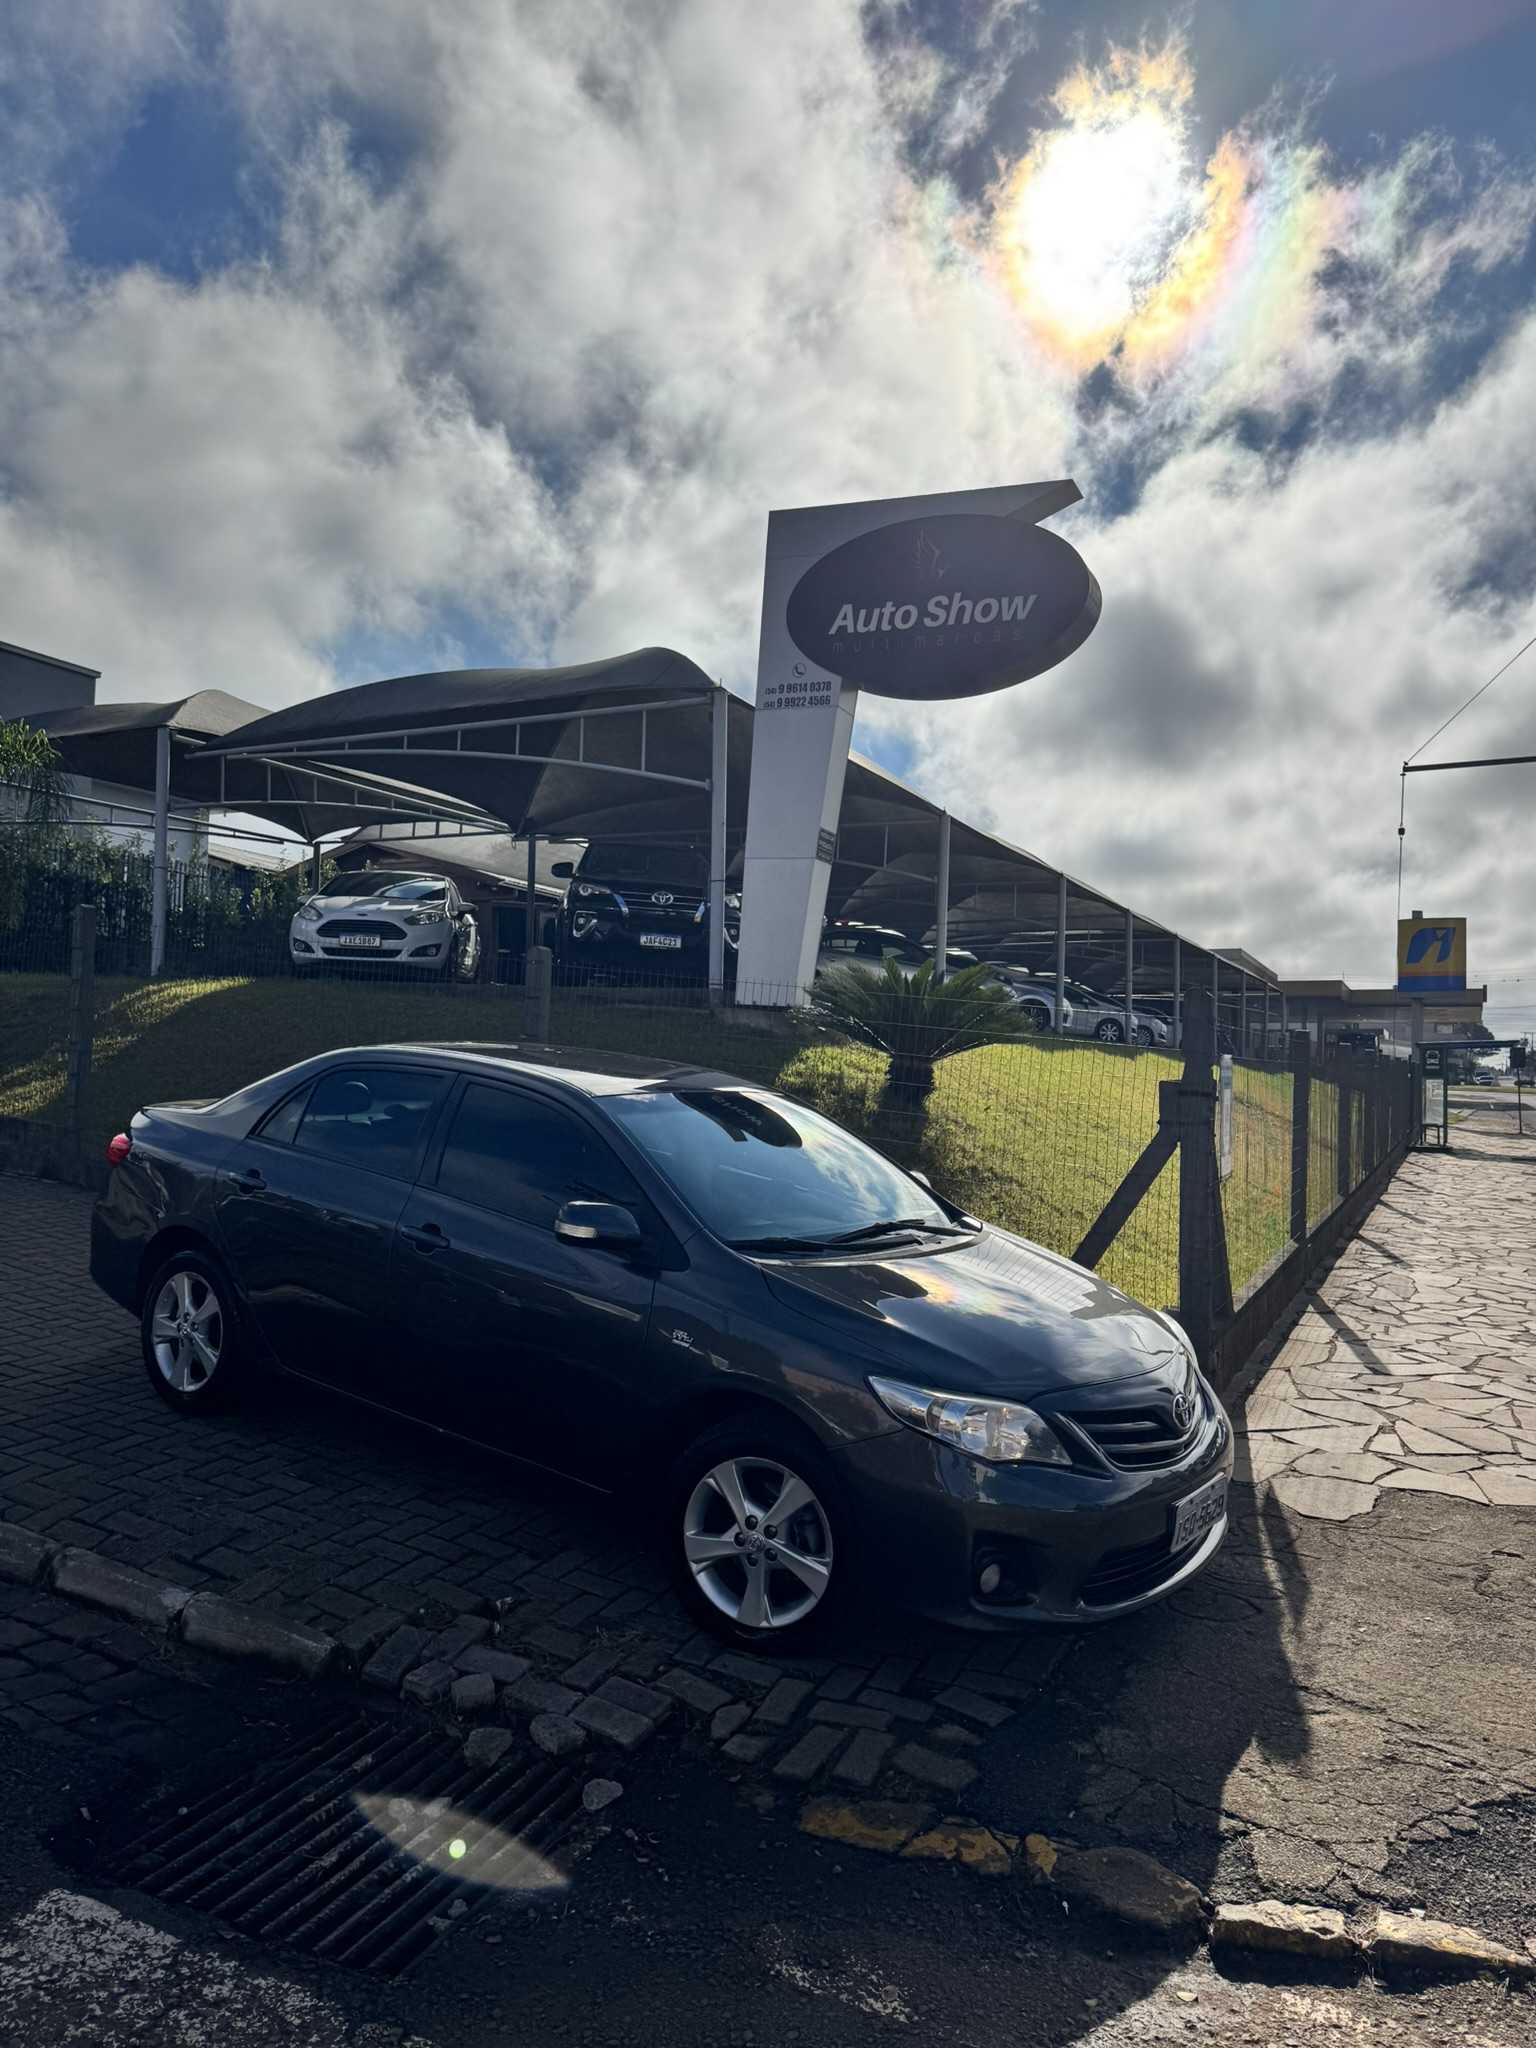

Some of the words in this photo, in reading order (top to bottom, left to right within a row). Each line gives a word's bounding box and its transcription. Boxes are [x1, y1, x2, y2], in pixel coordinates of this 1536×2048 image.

[829, 601, 919, 635] Auto
[923, 592, 1038, 628] Show
[778, 683, 785, 694] 9
[777, 697, 784, 708] 9
